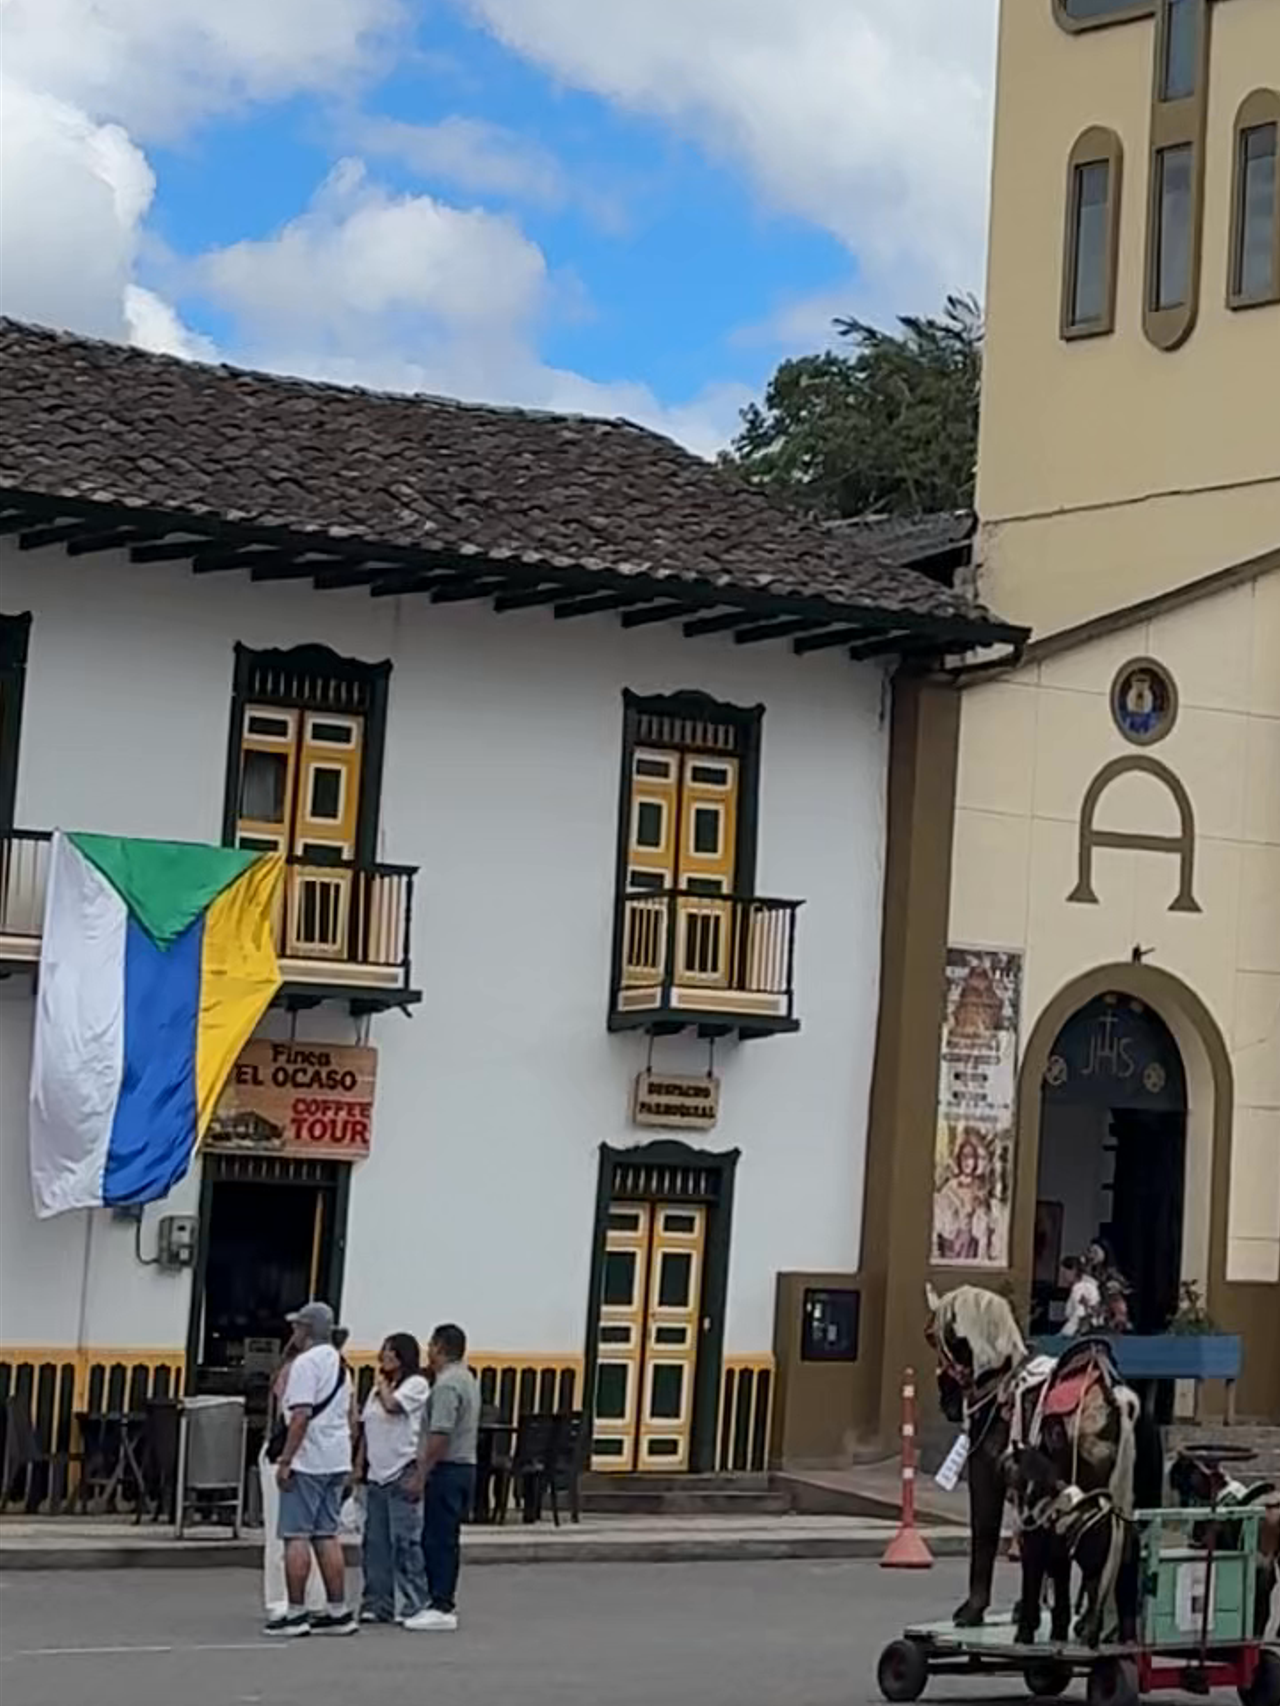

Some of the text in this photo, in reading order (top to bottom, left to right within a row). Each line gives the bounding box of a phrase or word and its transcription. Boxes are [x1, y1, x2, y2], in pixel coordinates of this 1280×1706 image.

[1065, 754, 1203, 914] A
[271, 1044, 332, 1067] Finca
[235, 1064, 358, 1092] EL OCASO
[292, 1098, 371, 1119] COFFEE
[290, 1118, 370, 1145] TOUR
